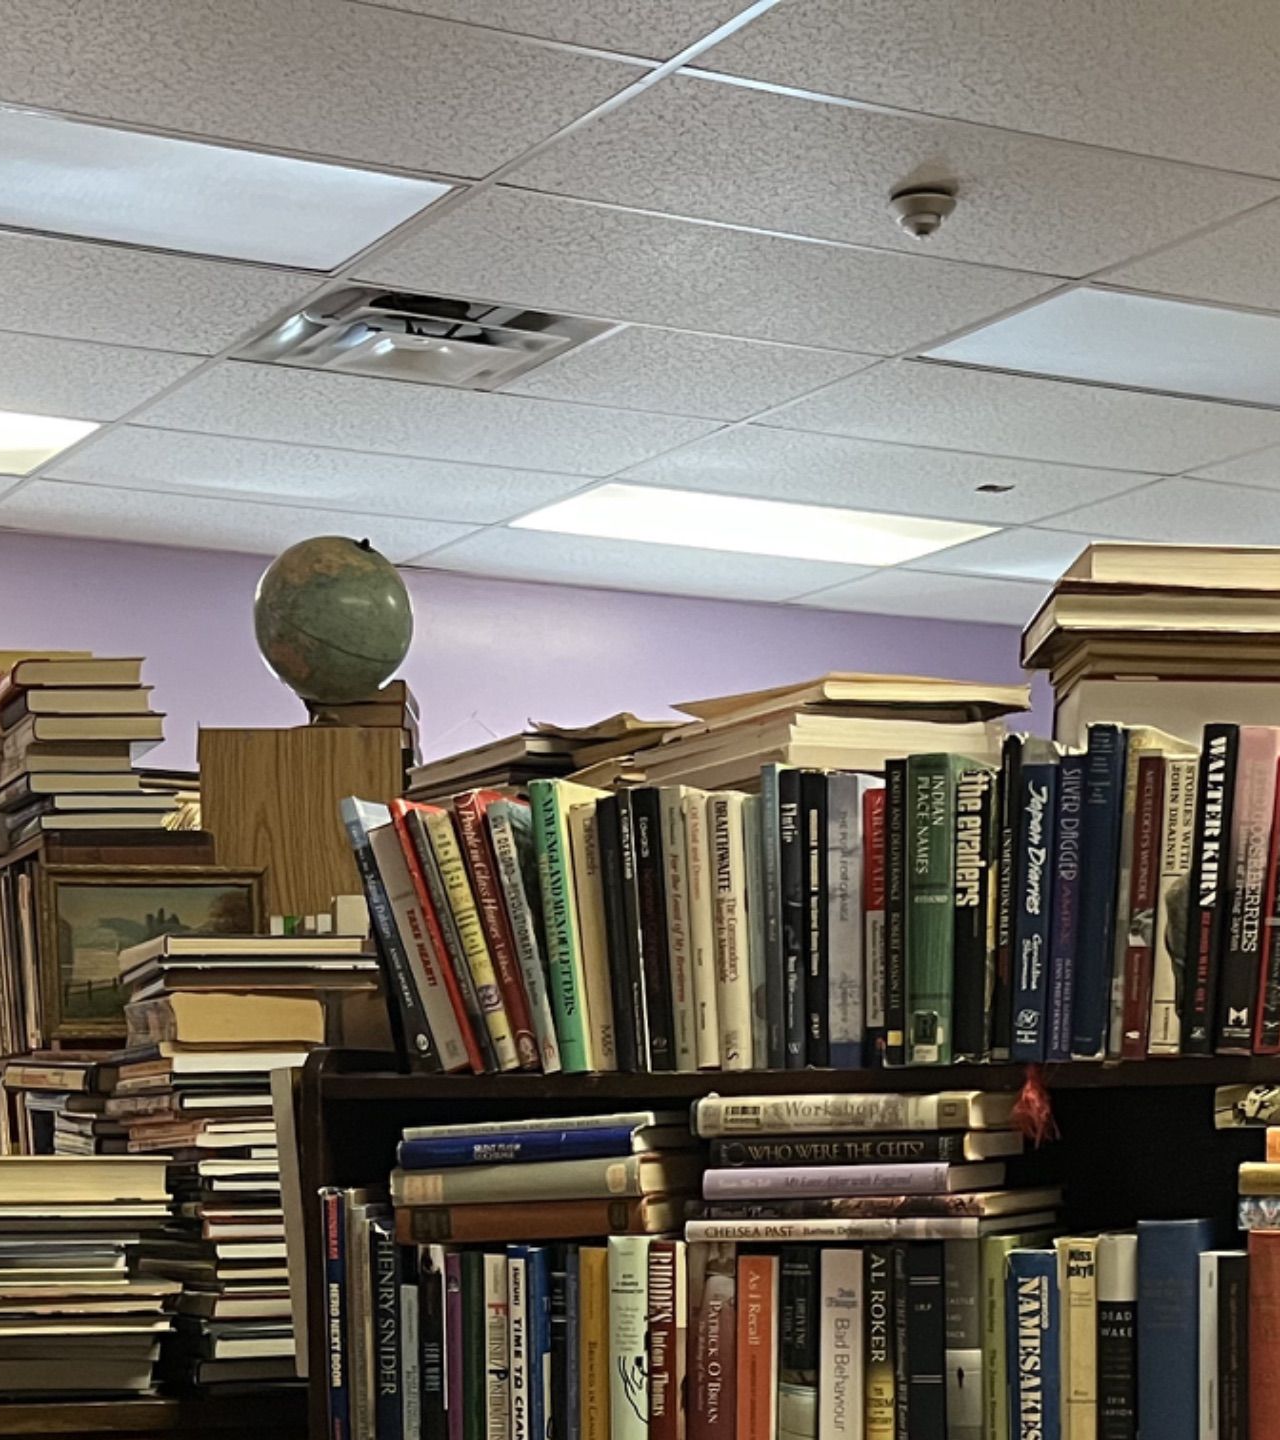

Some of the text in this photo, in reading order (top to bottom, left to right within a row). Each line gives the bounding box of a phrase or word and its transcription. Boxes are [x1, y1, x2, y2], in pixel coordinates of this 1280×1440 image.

[932, 775, 945, 826] INDIAN
[1058, 768, 1082, 880] SILVER DAGGER
[1169, 764, 1181, 802] JOHN
[1180, 765, 1196, 870] STORIES WITH
[1198, 735, 1227, 907] WALTER KIRN
[472, 863, 489, 897] Glass
[714, 801, 731, 892] BRAITHWAITE
[956, 773, 989, 907] the evaders
[999, 828, 1011, 945] UNMENTIONABLES
[1025, 781, 1049, 915] Japan Diaries
[405, 909, 422, 939] TAKE
[705, 1225, 760, 1239] CHELSEA
[378, 1241, 396, 1395] HENRY SNIDER
[648, 1252, 672, 1416] RHODES Thomas
[707, 1301, 722, 1355] PATRICK
[747, 1271, 761, 1345] As Recall
[871, 1254, 886, 1361] AL ROKER
[833, 1318, 849, 1432] Bad Behaviour
